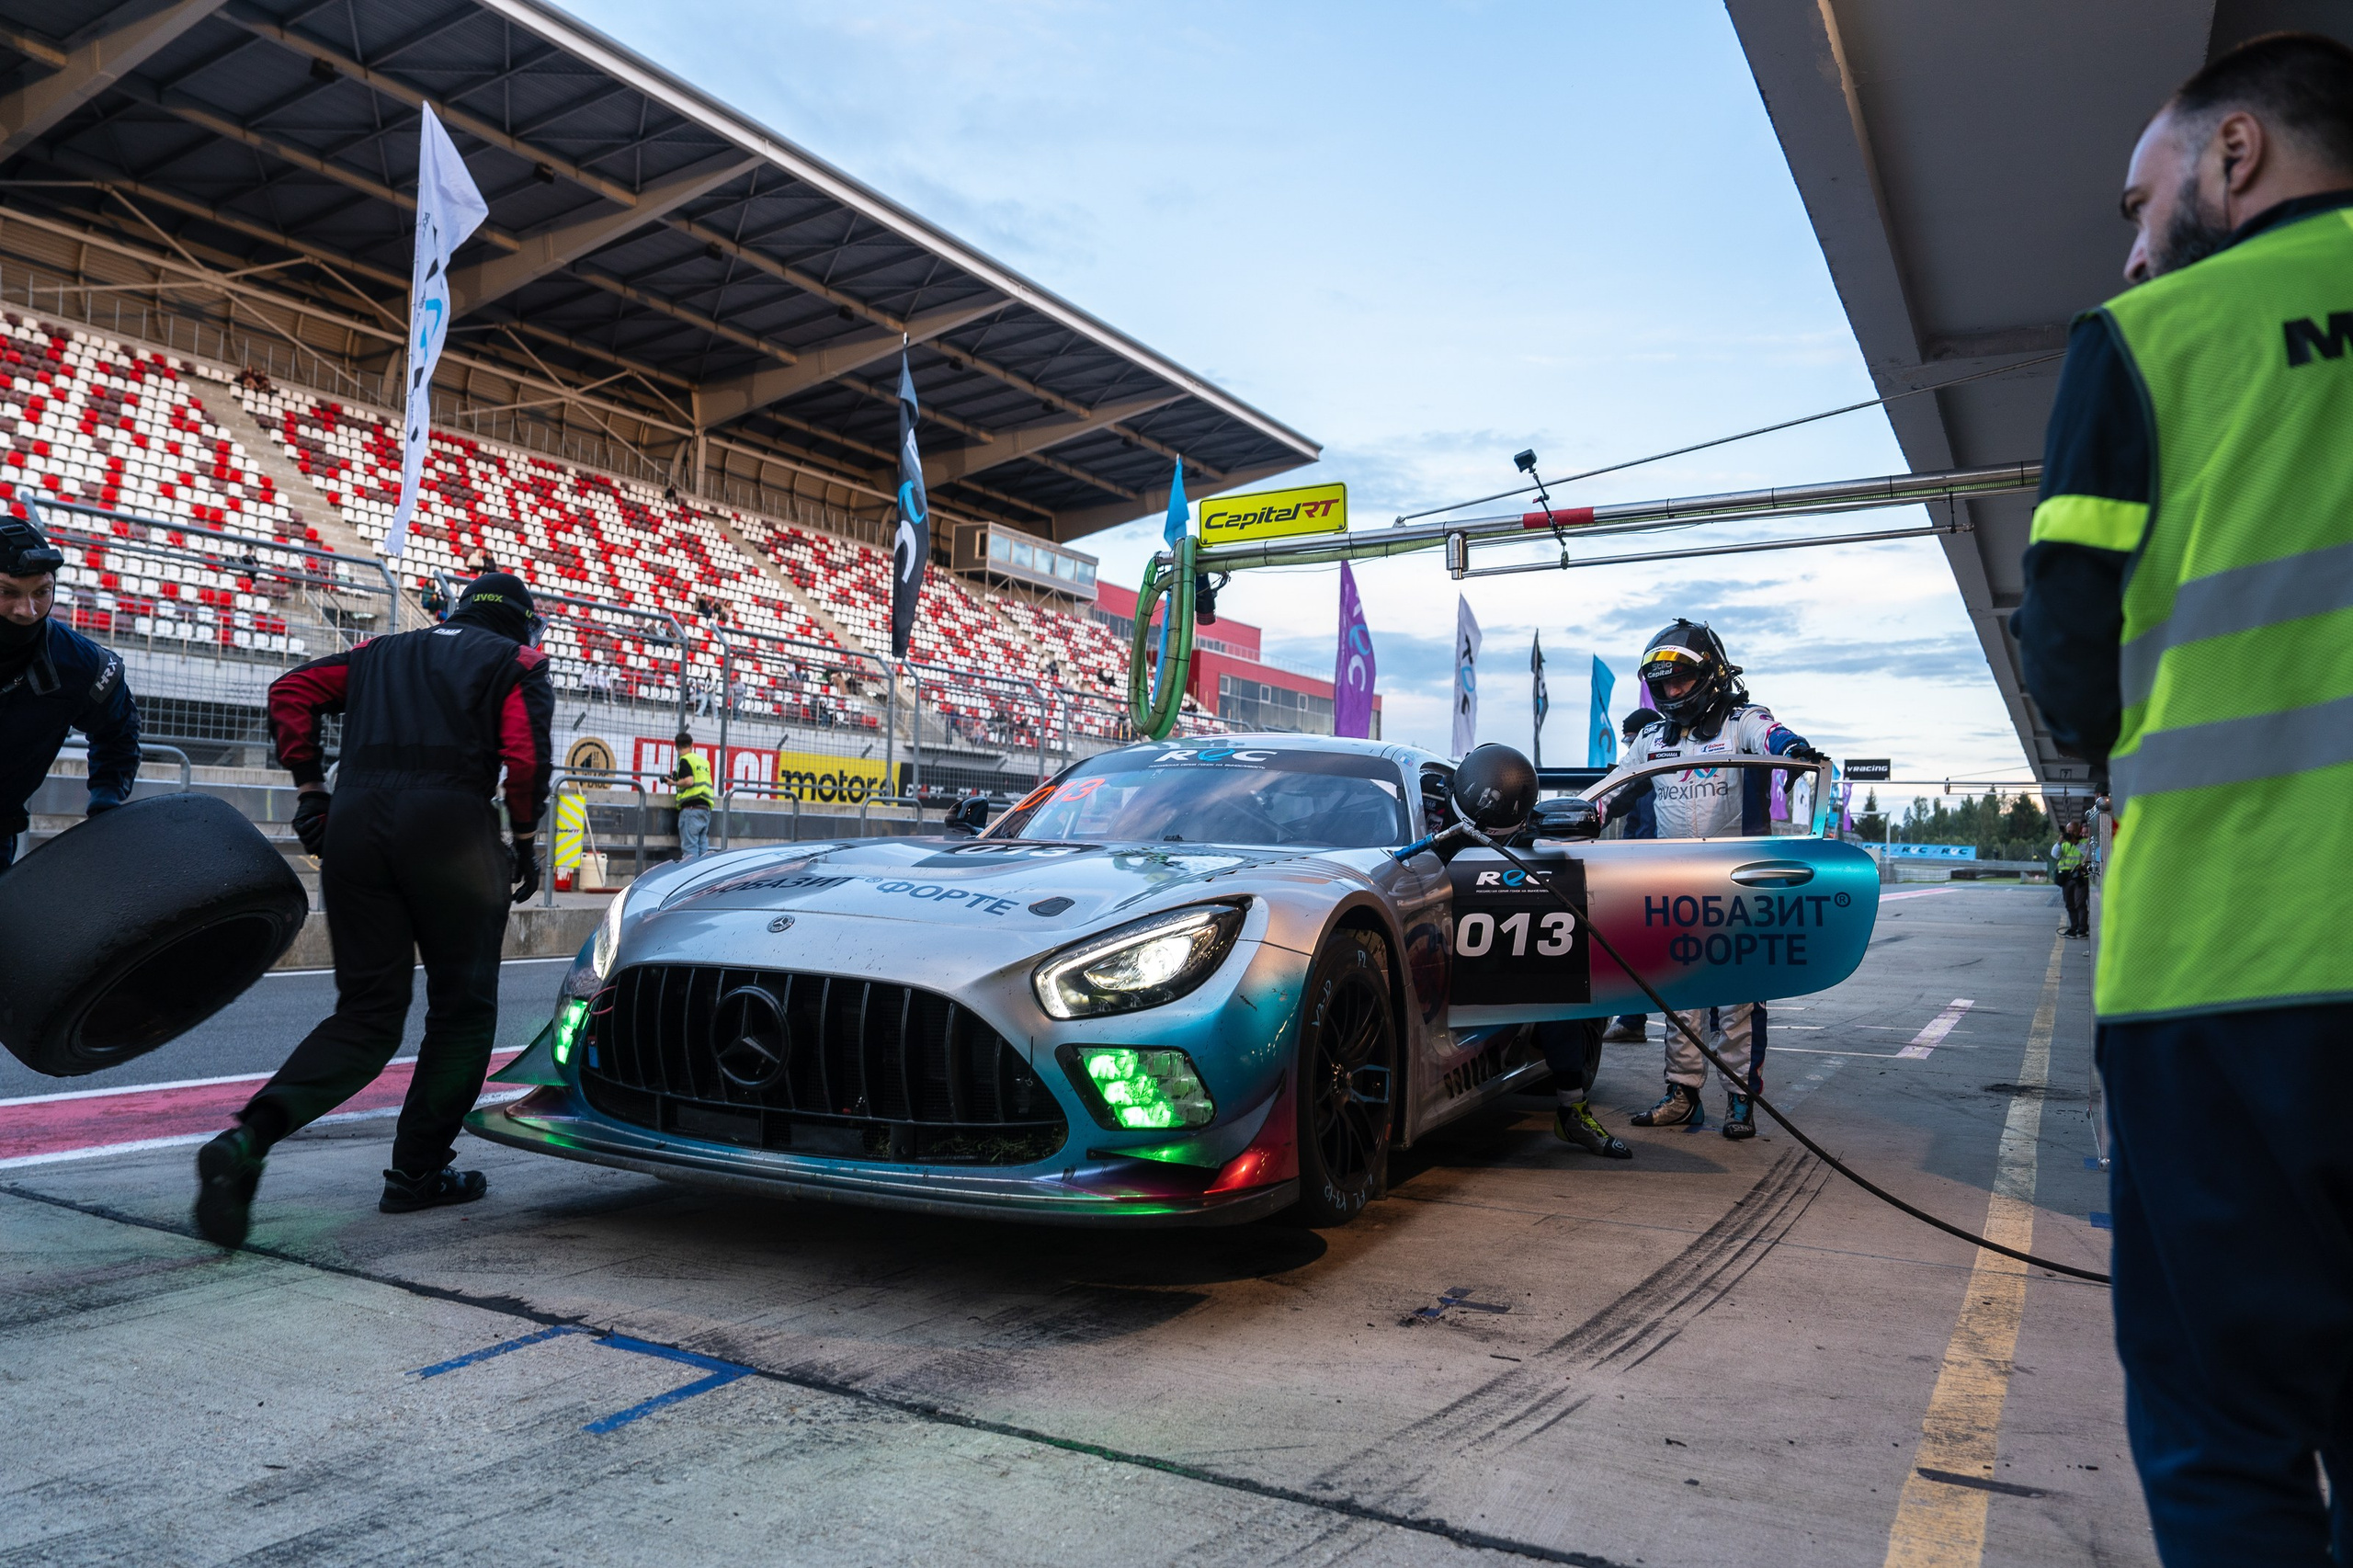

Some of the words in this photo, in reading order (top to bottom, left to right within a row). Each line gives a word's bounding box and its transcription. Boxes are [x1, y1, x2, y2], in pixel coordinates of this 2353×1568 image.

[1205, 499, 1340, 530] CapitalRT
[472, 593, 504, 603] uvex
[95, 655, 118, 691] HRX
[1652, 662, 1673, 671] Stilo
[1015, 778, 1106, 812] 013
[1657, 780, 1728, 801] avexima
[955, 845, 1081, 858] 013
[876, 881, 1020, 916] ФОРТЕ
[1456, 912, 1575, 957] 013
[1669, 933, 1808, 965] ФОРТЕ
